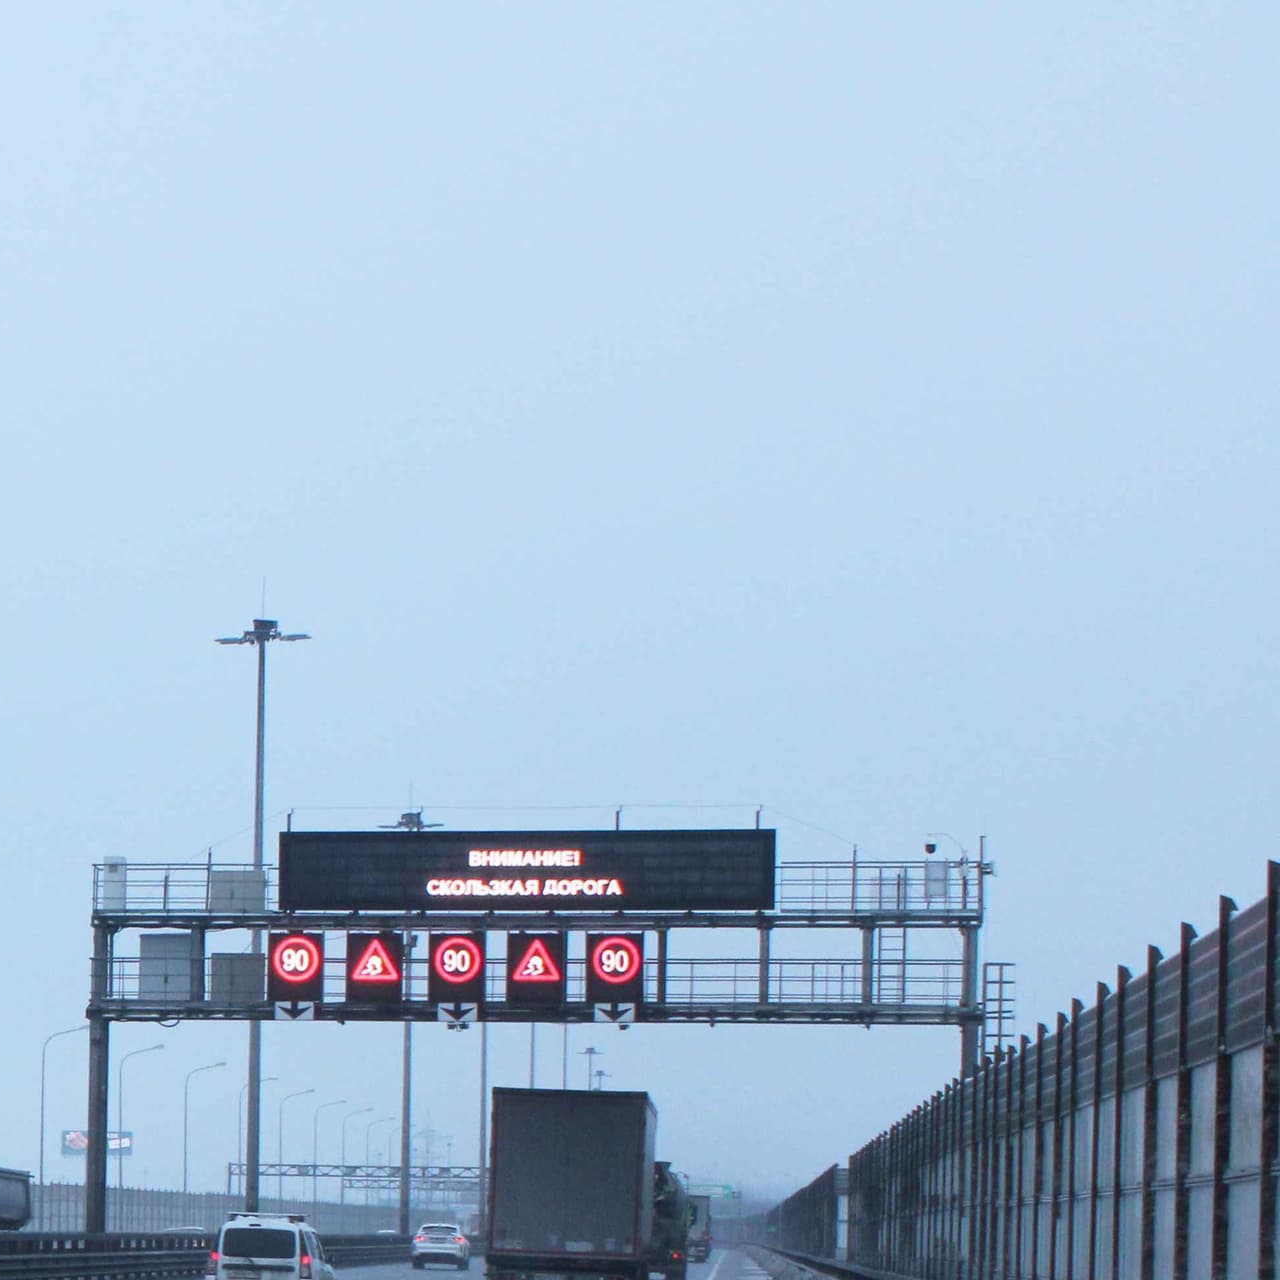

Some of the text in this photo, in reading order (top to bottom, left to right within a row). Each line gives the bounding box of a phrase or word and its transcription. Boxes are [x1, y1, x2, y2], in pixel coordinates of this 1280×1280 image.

[468, 849, 582, 867] ВНИМАНИЕ!
[426, 879, 623, 897] СКОЛЬЗКАЯ ДОРОГА
[282, 948, 309, 972] 90
[443, 948, 470, 972] 90
[602, 948, 629, 972] 90
